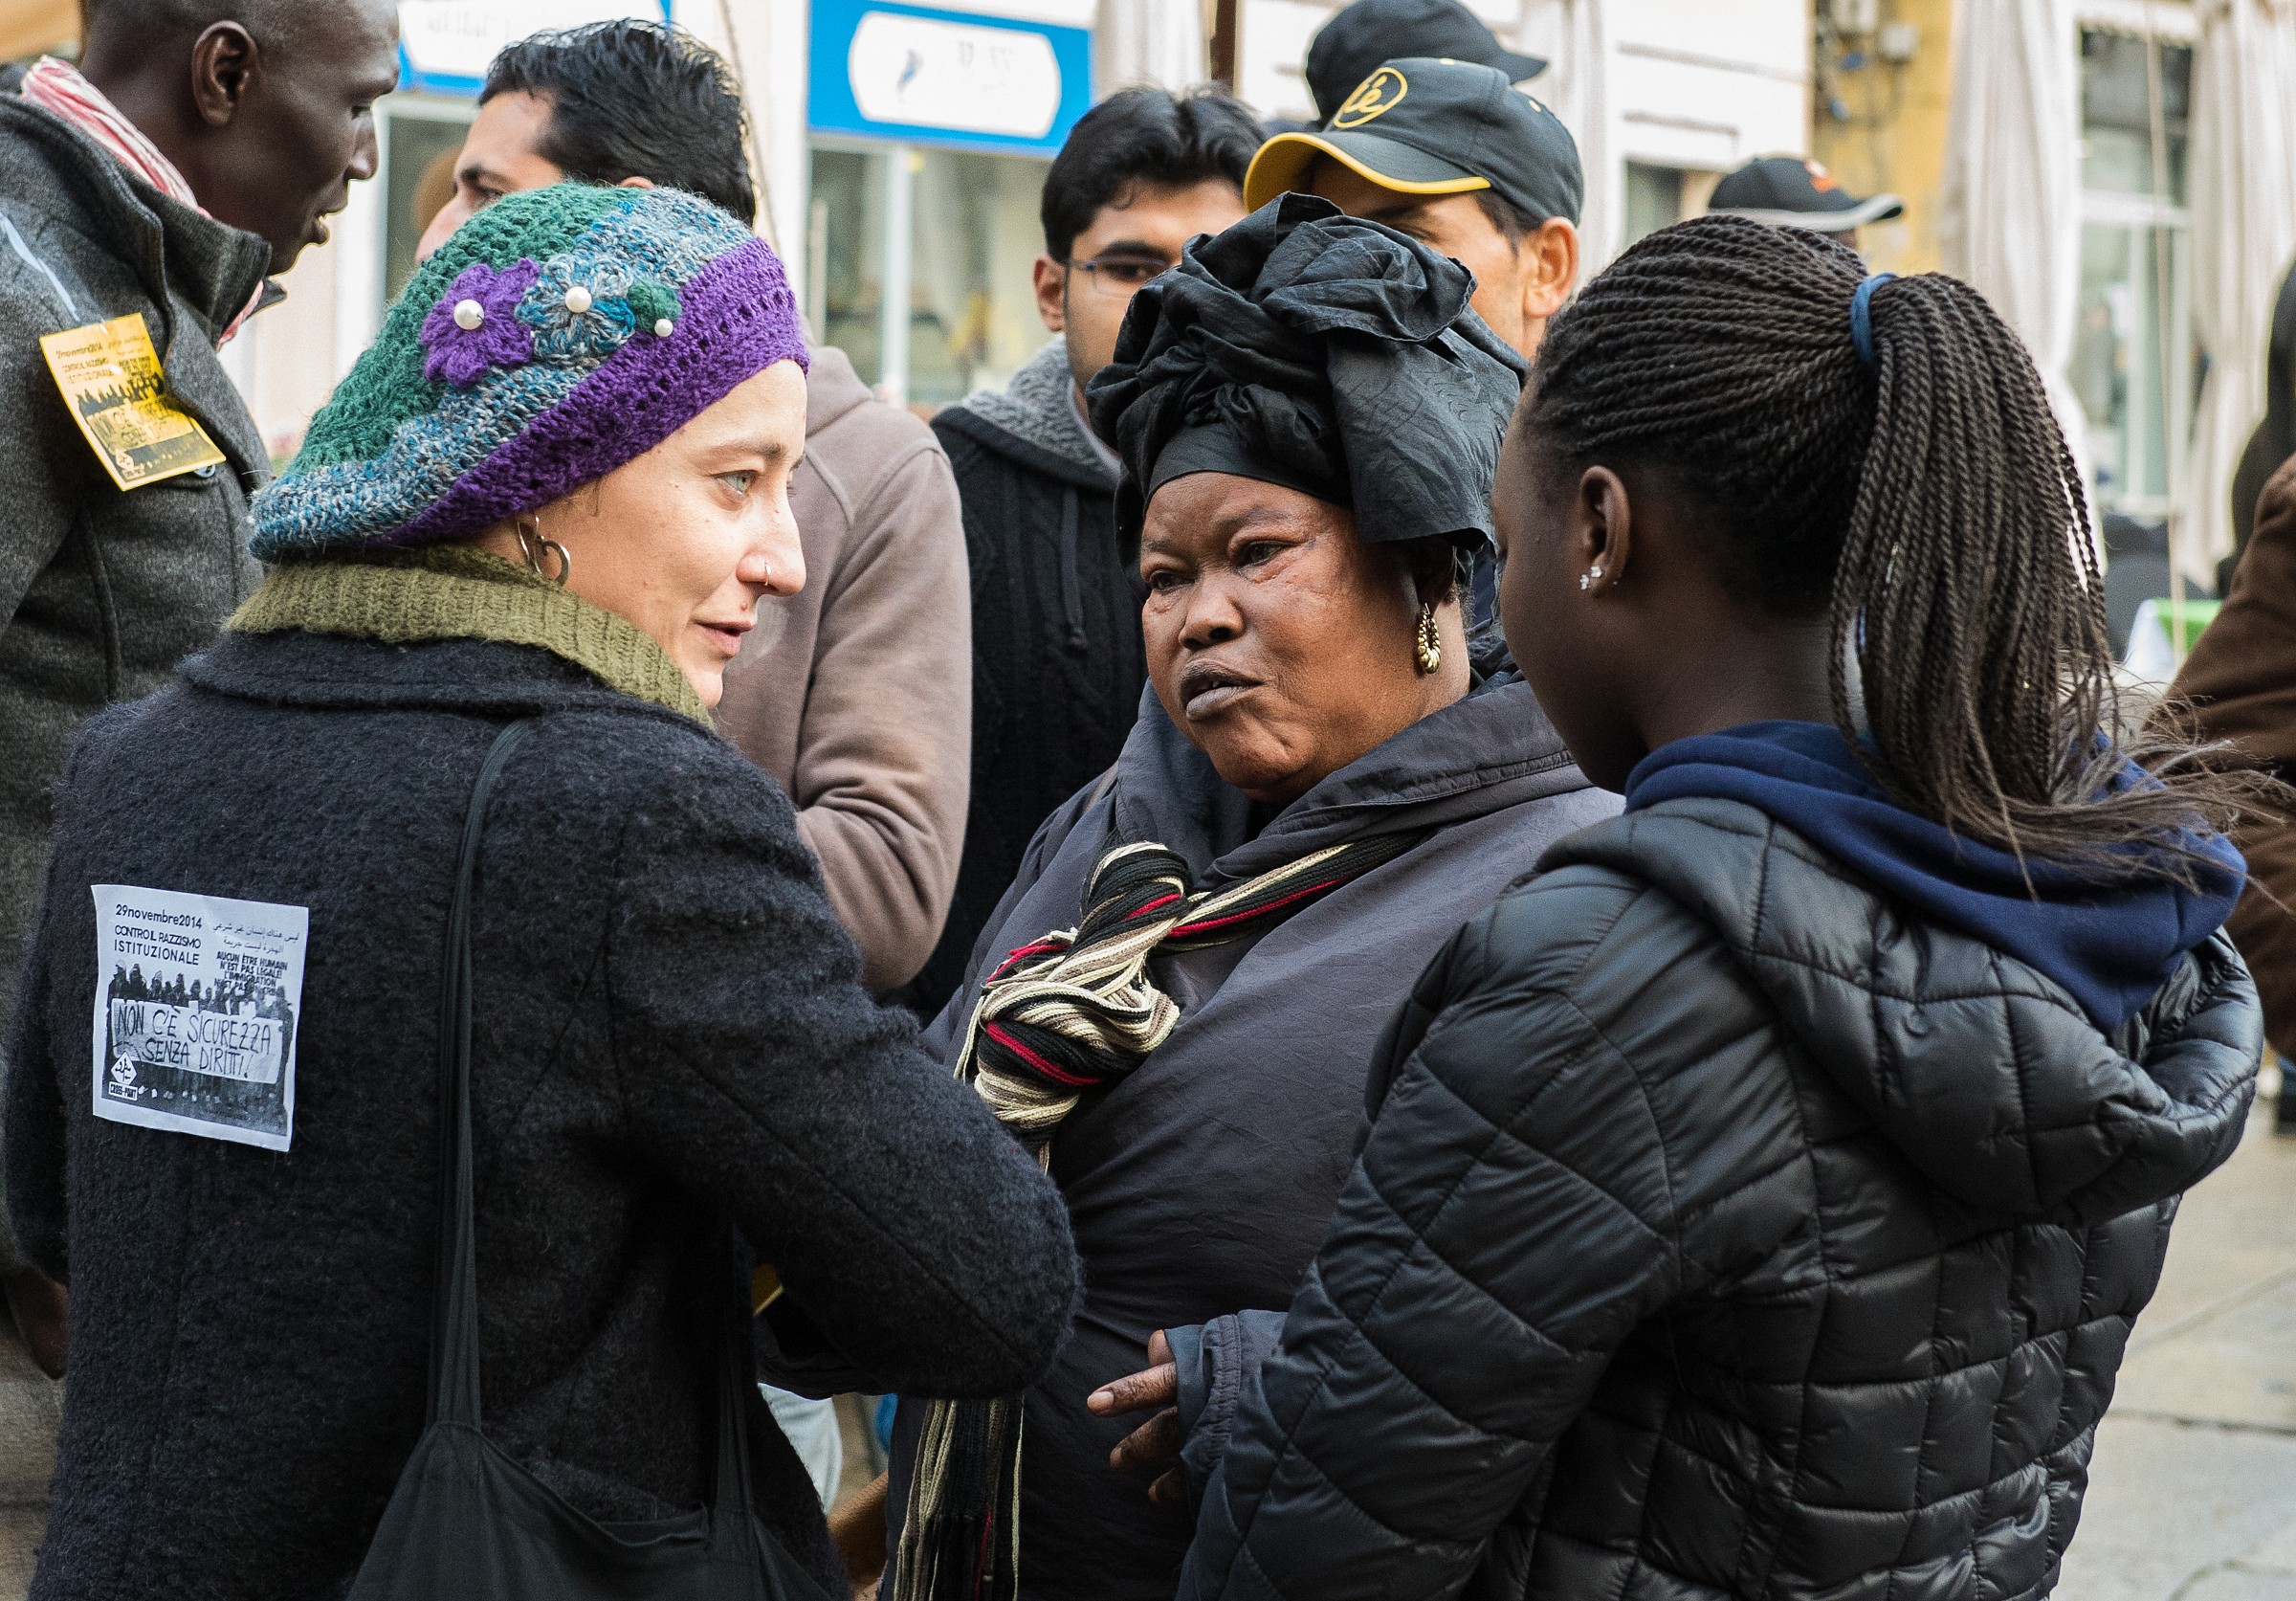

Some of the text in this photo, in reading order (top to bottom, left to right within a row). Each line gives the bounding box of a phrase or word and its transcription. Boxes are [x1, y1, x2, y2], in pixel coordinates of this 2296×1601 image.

[116, 903, 203, 929] 29novembre2014
[114, 939, 200, 966] ISTITUZIONALE
[158, 932, 202, 949] RAZZISMO
[216, 950, 241, 963] AUCUN
[240, 964, 254, 974] PAS
[117, 1005, 144, 1036] NON
[187, 1014, 273, 1056] SICUREZZA
[142, 1037, 190, 1066] SENZA
